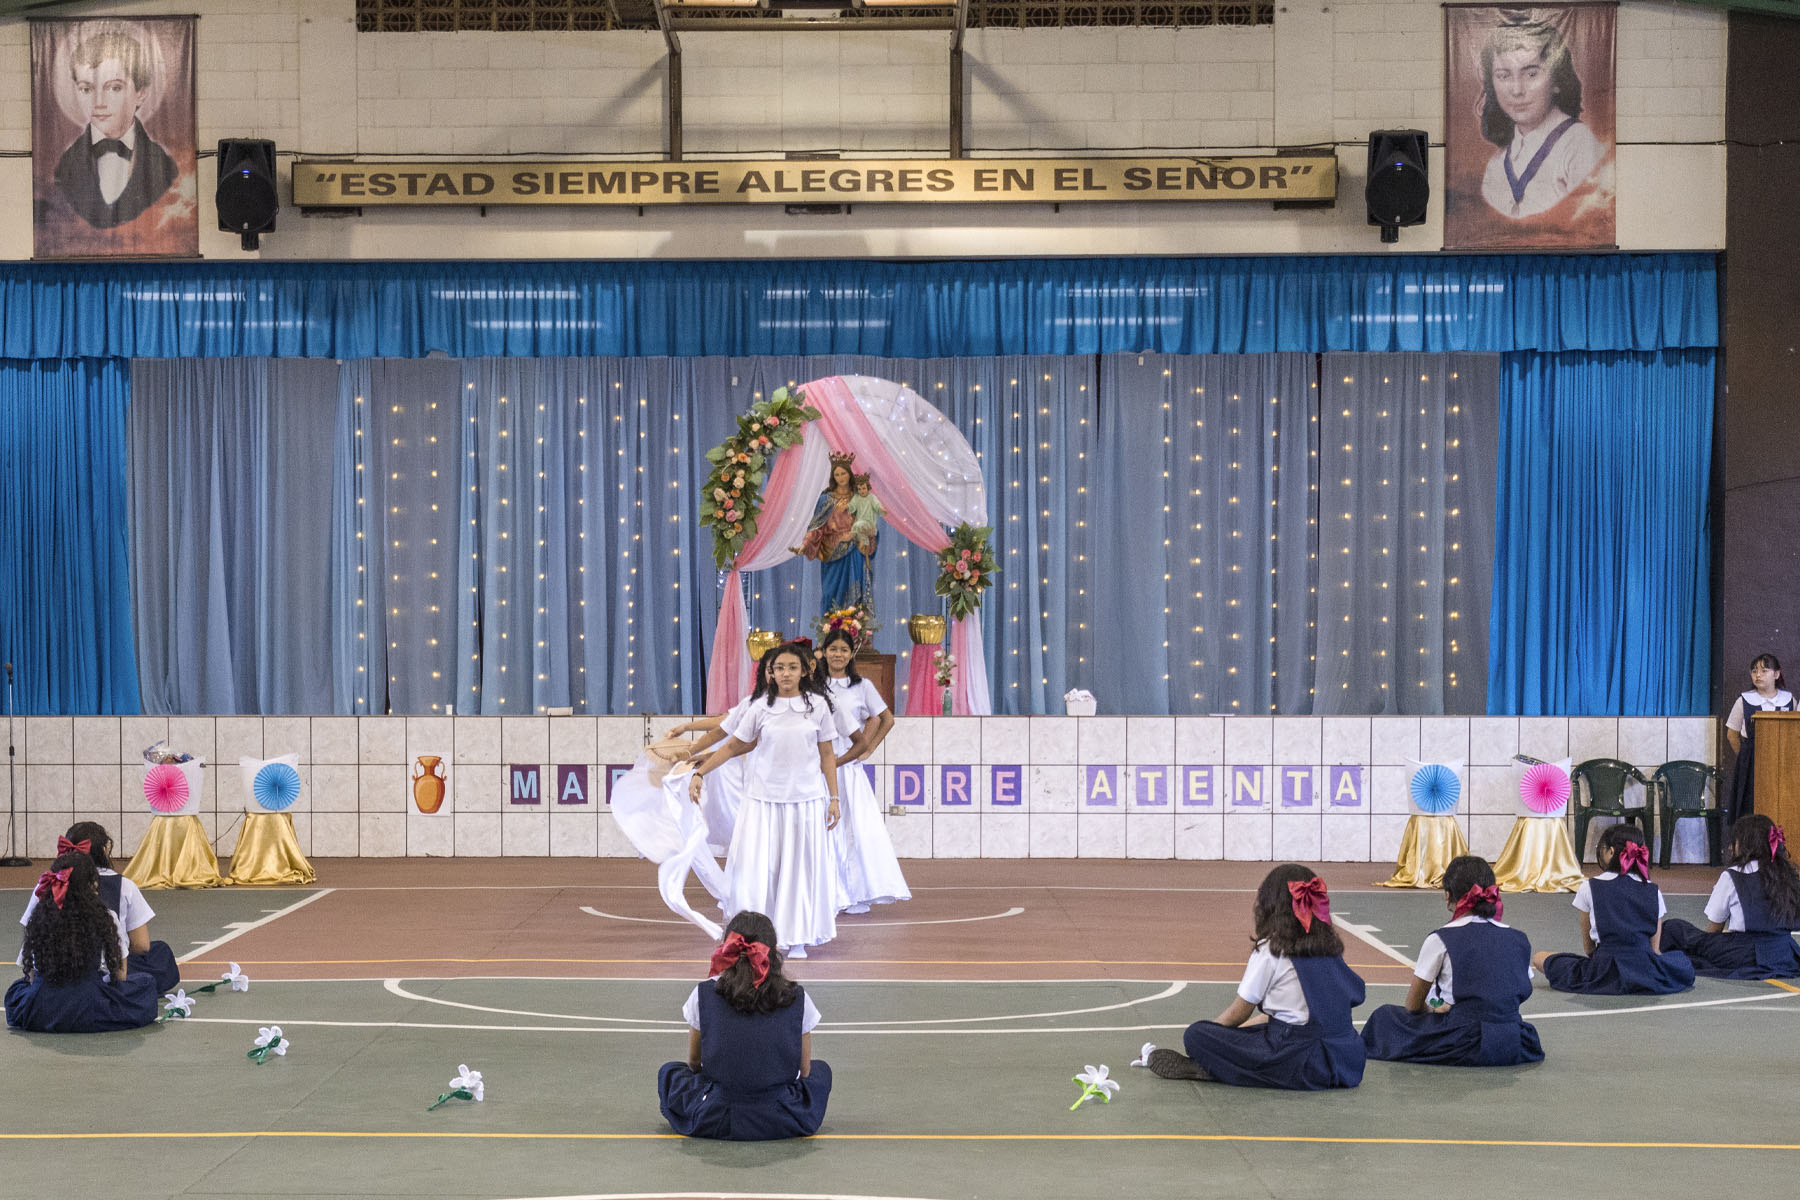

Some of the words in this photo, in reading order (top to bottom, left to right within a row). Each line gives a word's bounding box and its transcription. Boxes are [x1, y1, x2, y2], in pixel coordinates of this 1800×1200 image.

[512, 170, 720, 195] SIEMPRE
[736, 168, 956, 193] ALEGRES
[973, 168, 1034, 192] EN
[1053, 168, 1108, 191] EL
[513, 769, 630, 801] MA
[899, 770, 1016, 802] DRE
[1090, 769, 1358, 801] ATENTA
